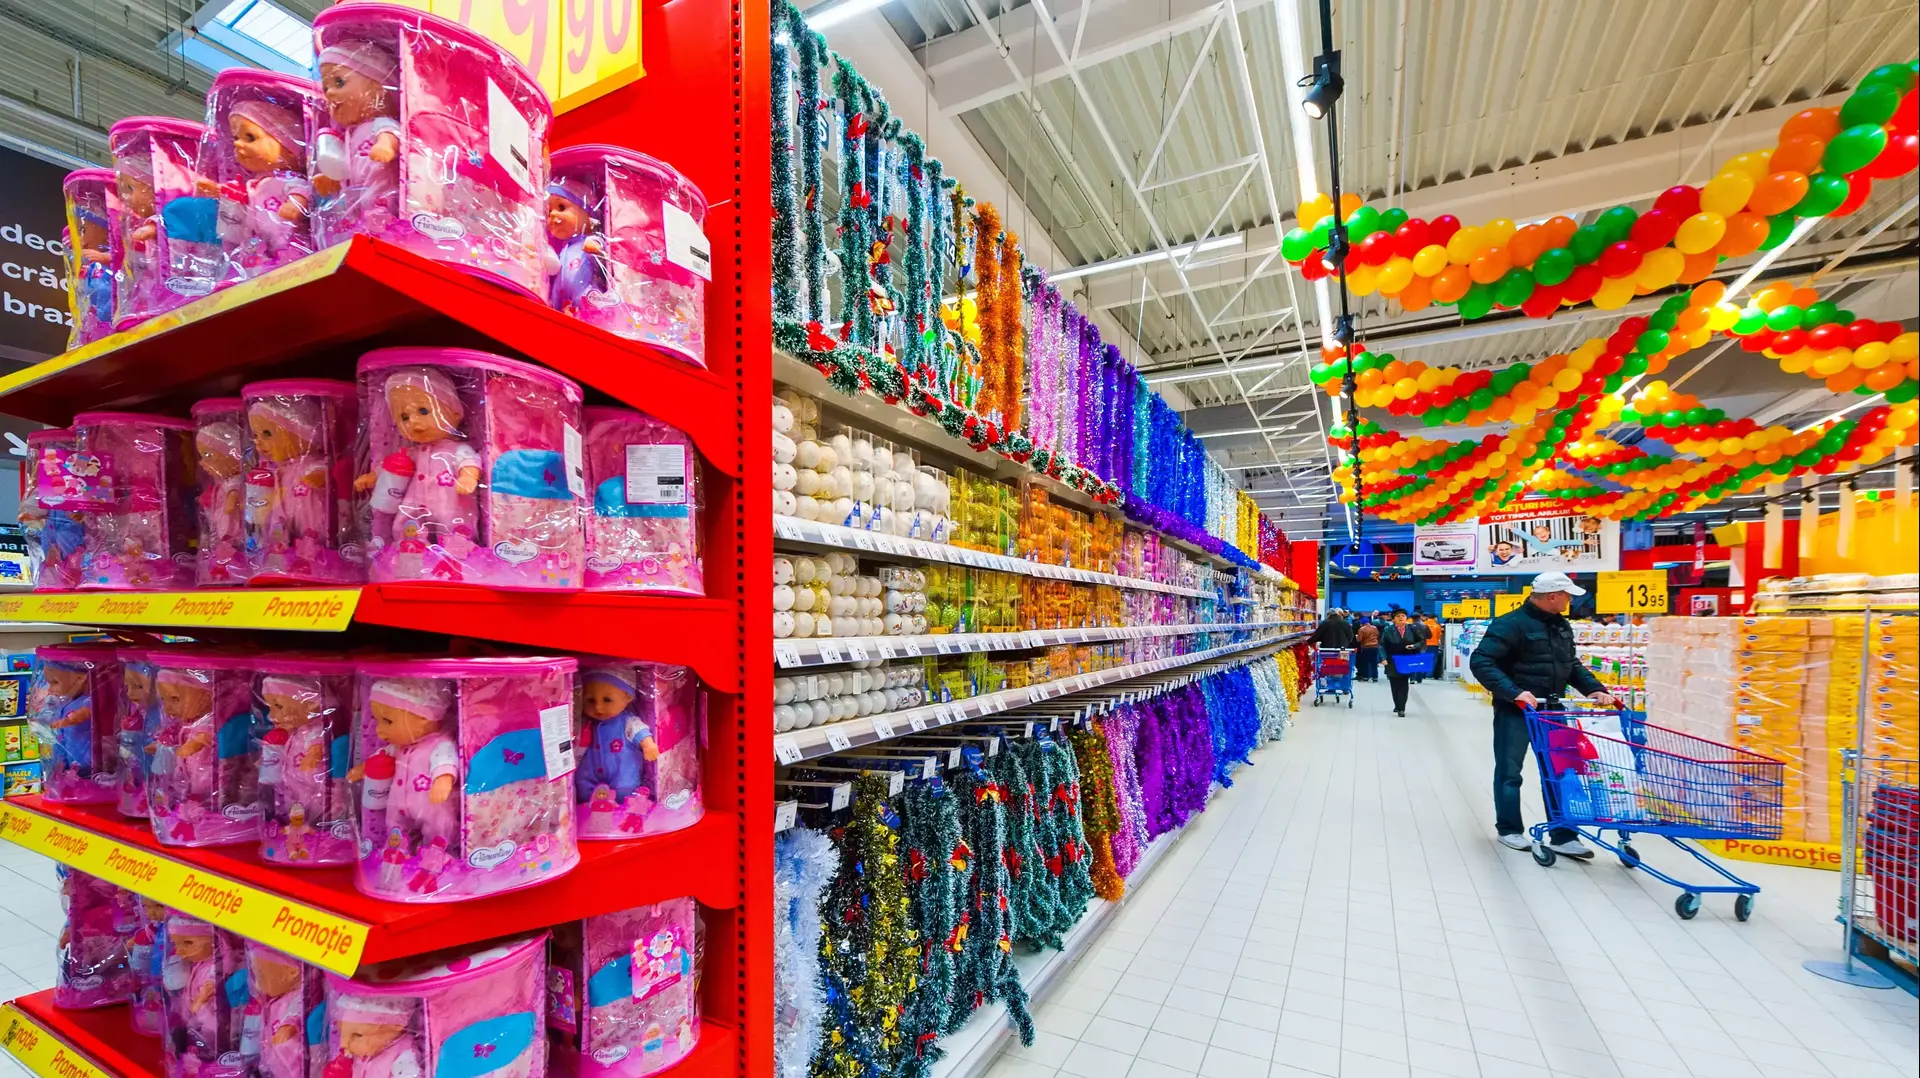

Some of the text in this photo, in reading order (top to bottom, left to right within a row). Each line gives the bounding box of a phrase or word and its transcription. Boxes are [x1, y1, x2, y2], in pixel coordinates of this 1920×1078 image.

[169, 596, 234, 621] Promoție
[263, 594, 344, 626] Promoție
[1473, 605, 1482, 615] 71
[1627, 584, 1665, 607] 13 95
[1450, 607, 1459, 616] 49
[44, 826, 89, 859] Promoție
[1725, 839, 1842, 865] Promoție
[104, 847, 158, 885] Promoție
[179, 873, 243, 917] Promoție
[272, 906, 353, 959] Promoție
